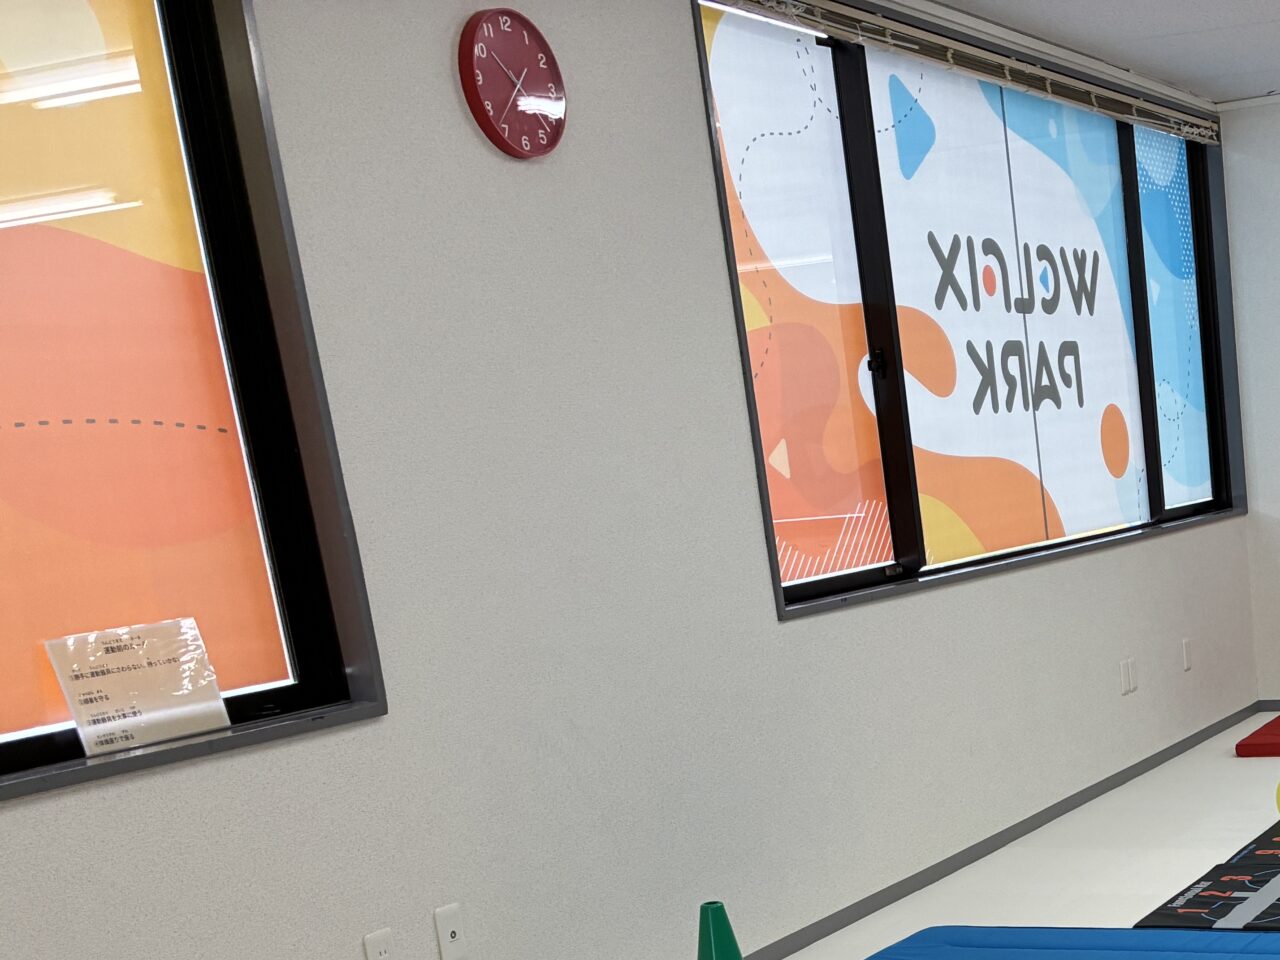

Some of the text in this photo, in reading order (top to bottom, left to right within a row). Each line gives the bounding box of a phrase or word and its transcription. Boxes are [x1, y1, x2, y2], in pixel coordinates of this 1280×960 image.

[483, 23, 494, 38] 11
[499, 16, 512, 32] 12
[523, 30, 529, 45] 1
[475, 43, 487, 58] 10
[538, 53, 547, 68] 2
[547, 83, 556, 98] 3
[485, 101, 494, 116] 8
[501, 124, 509, 138] 7
[538, 130, 547, 144] 5
[522, 136, 531, 151] 6
